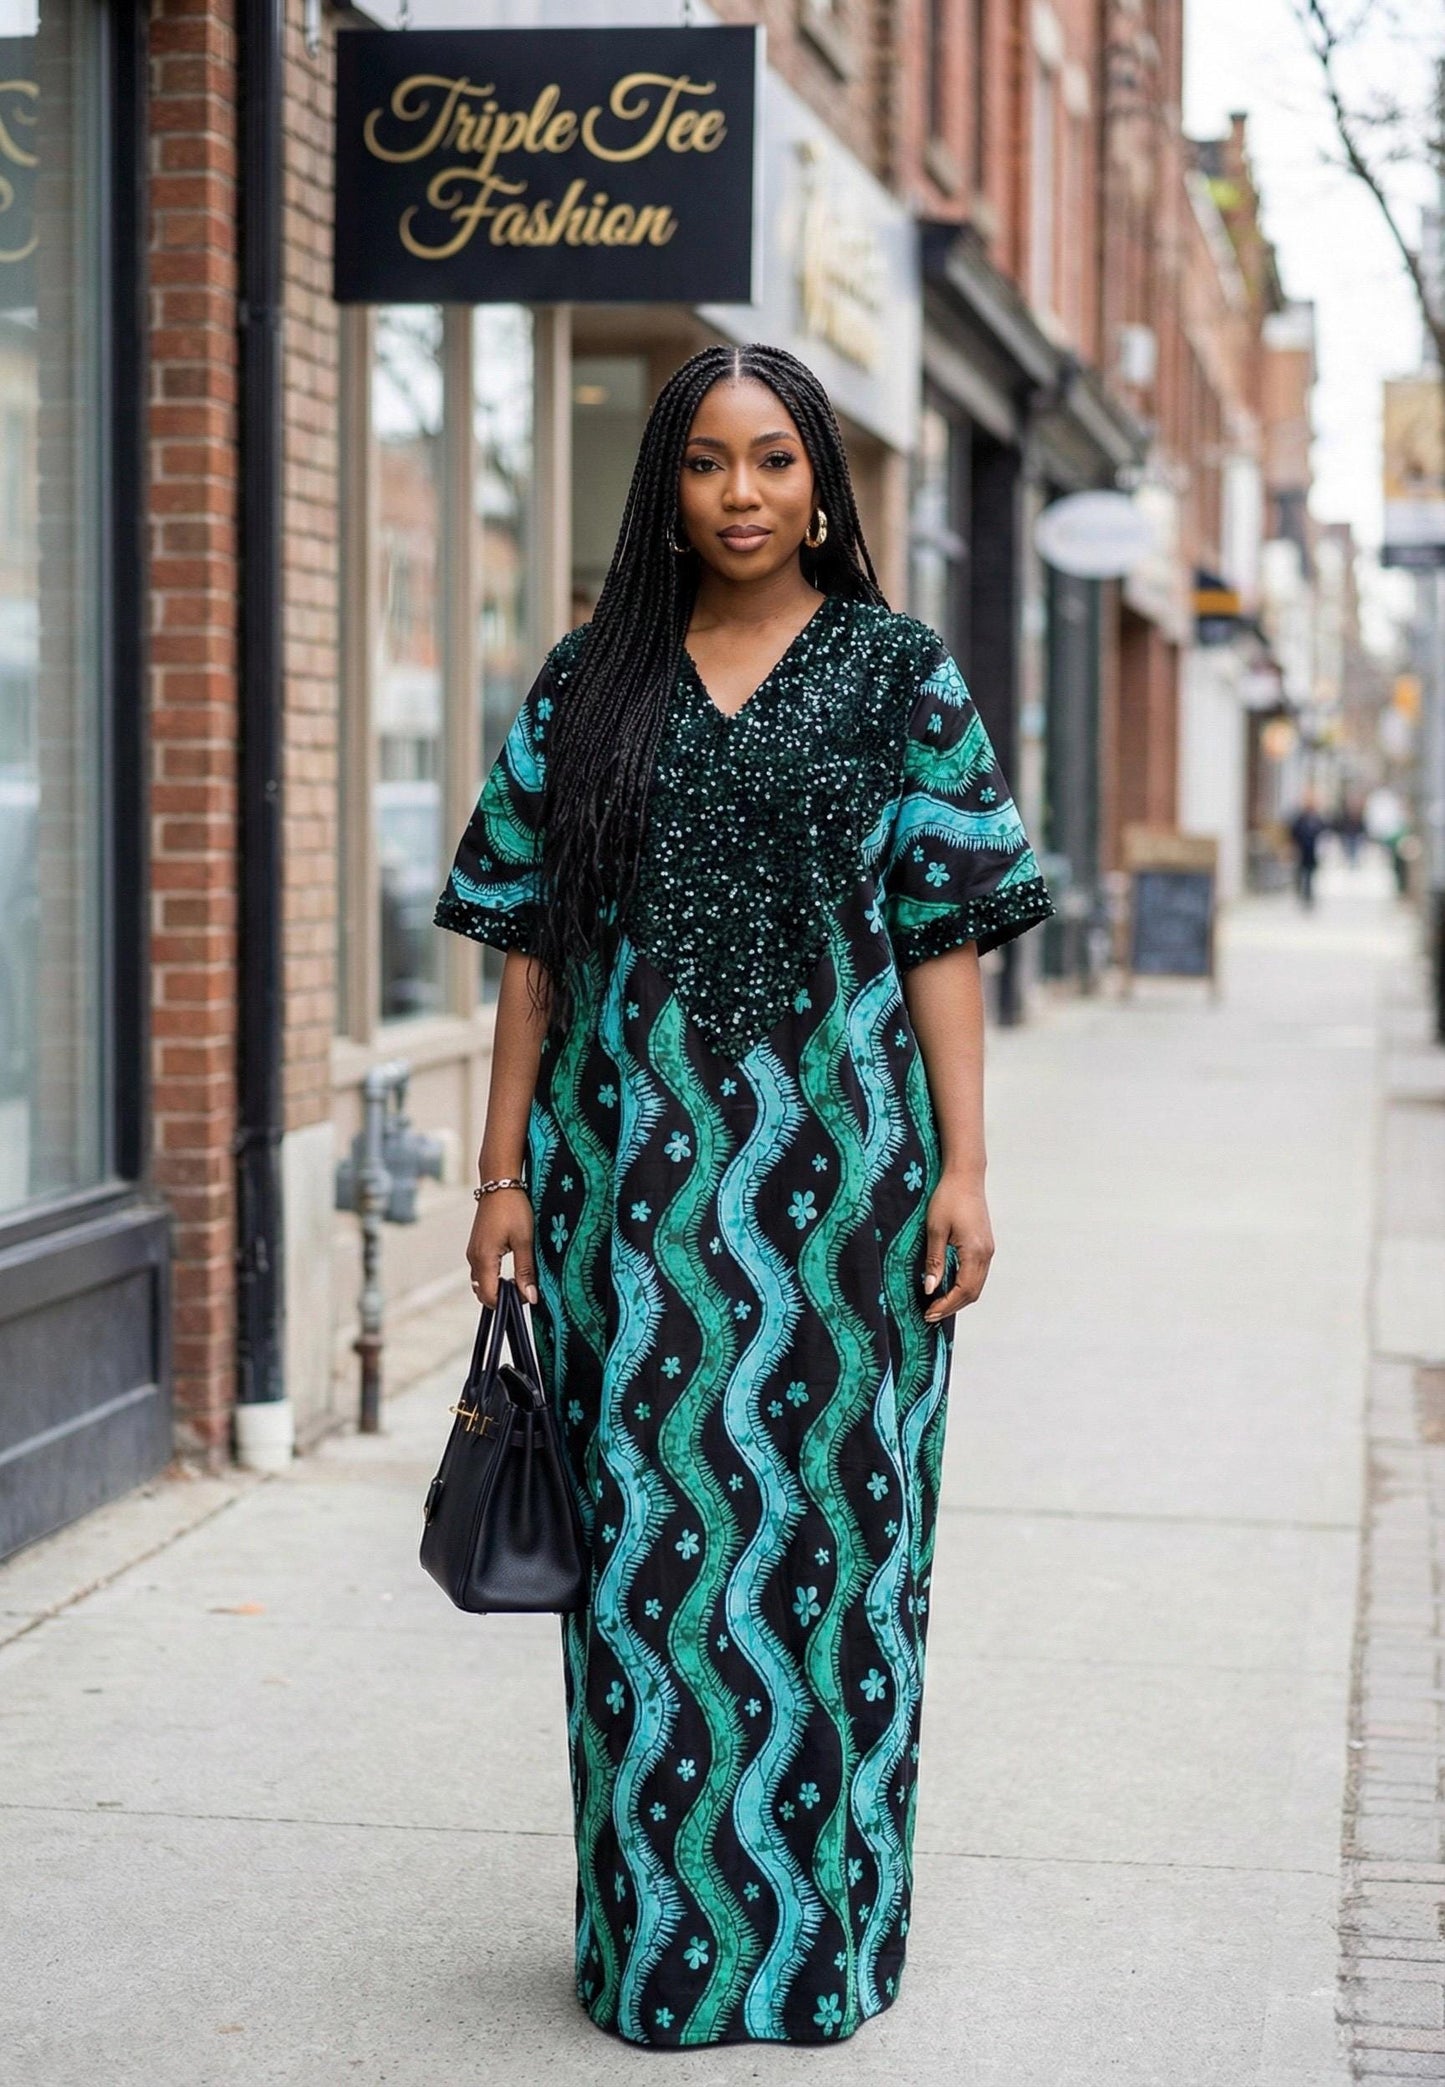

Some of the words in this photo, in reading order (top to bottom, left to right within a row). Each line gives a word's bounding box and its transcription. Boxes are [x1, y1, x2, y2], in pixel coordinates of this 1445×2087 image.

[363, 74, 579, 178] Triple
[581, 72, 728, 163] Tee
[400, 166, 678, 260] Fashion
